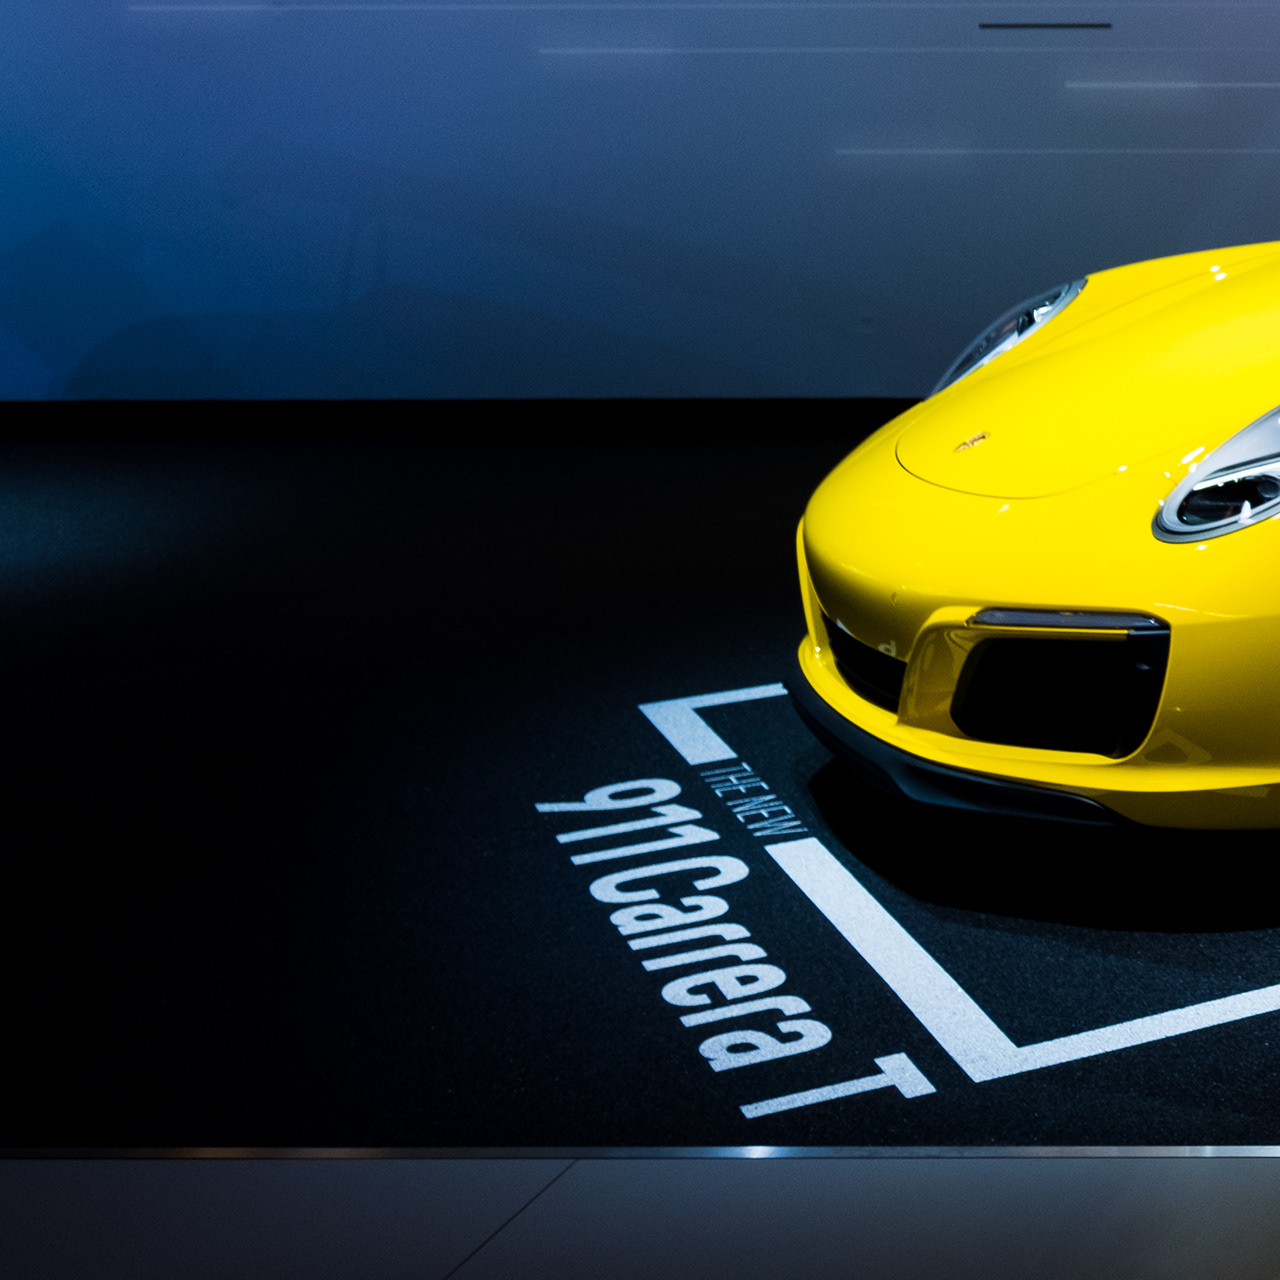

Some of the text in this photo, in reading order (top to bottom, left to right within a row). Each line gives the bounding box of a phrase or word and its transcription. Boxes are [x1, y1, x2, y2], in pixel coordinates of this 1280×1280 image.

[700, 761, 808, 837] THE NEW
[535, 778, 937, 1119] 911 Carrera T
